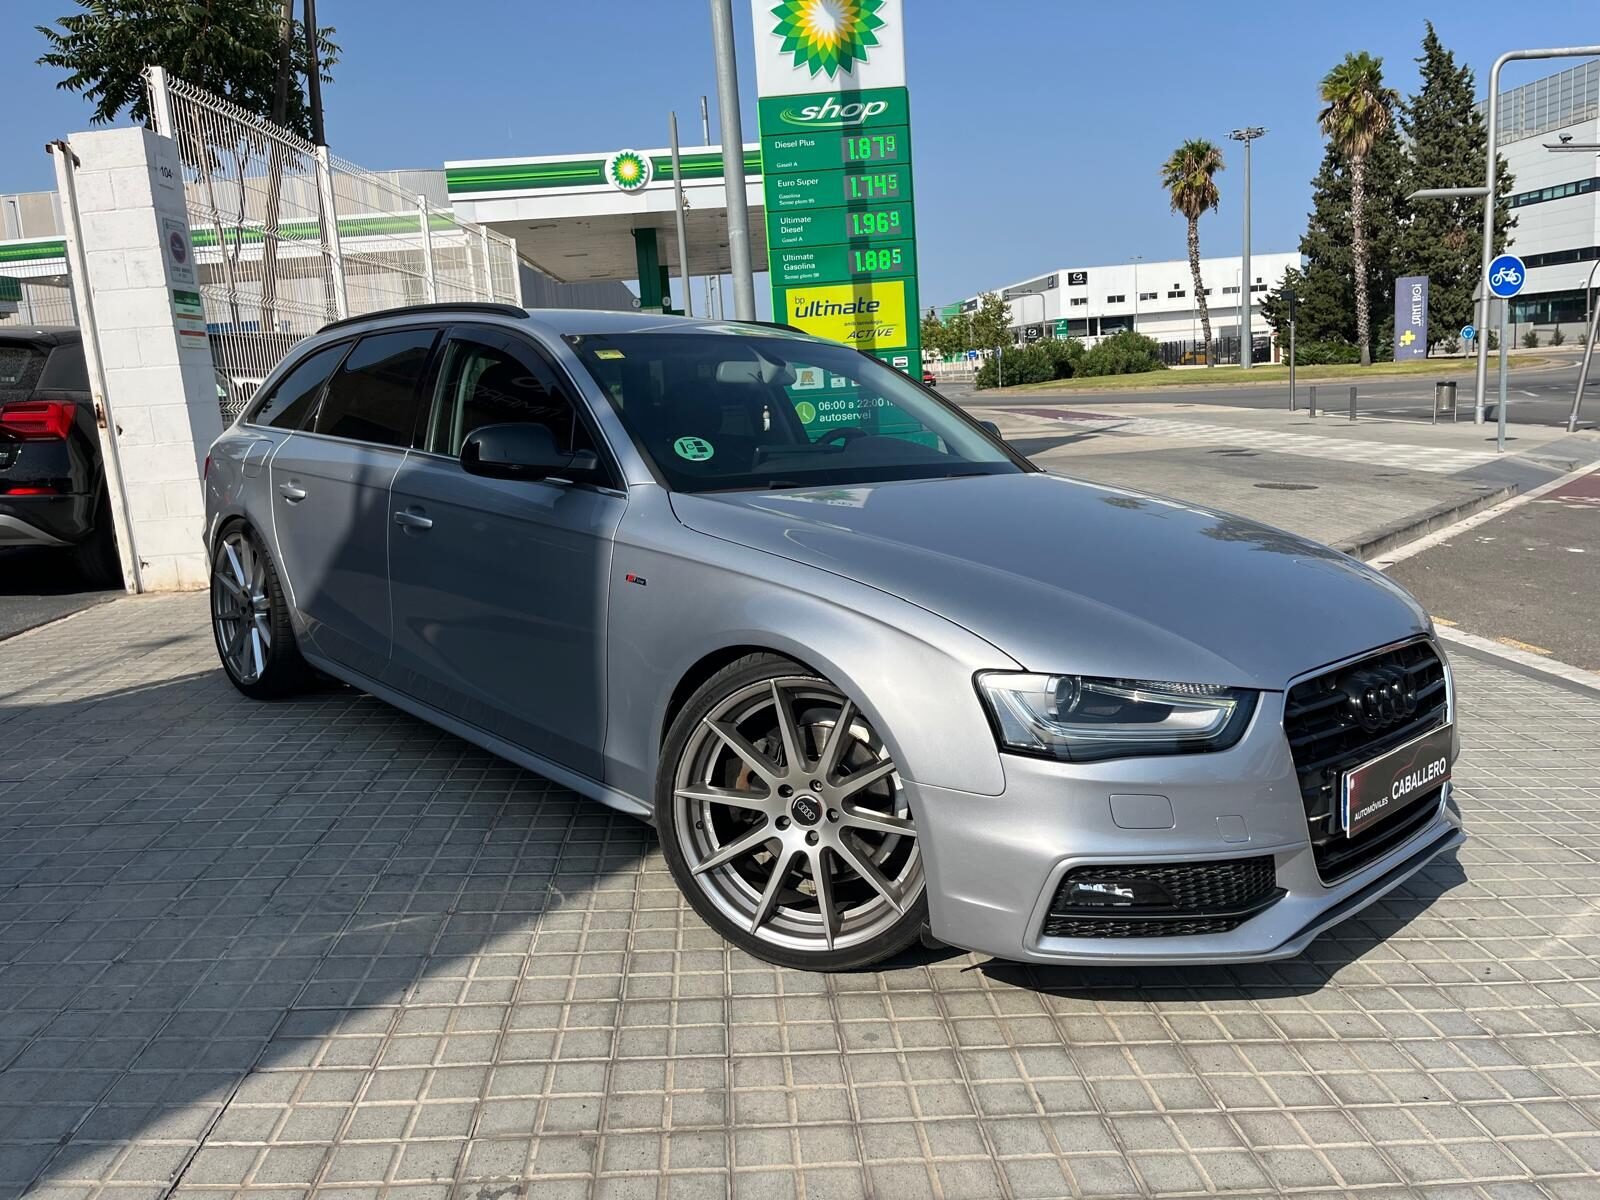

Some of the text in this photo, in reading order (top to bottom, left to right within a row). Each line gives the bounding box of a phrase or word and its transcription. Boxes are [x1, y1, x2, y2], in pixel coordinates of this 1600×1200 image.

[800, 97, 888, 123] shop
[775, 139, 816, 149] Diesel Plus
[778, 178, 819, 188] Euro Super
[780, 216, 812, 224] Ultimate
[781, 225, 803, 234] Diesel
[783, 253, 814, 261] Ultimate
[783, 262, 816, 271] Gasolina
[795, 296, 805, 306] bp
[795, 297, 880, 318] ultimate
[847, 327, 894, 339] ACTIVE
[818, 401, 846, 411] 06:00
[857, 398, 884, 409] 22:00
[1354, 757, 1446, 821] AUTOMÓVILES CABALLERO
